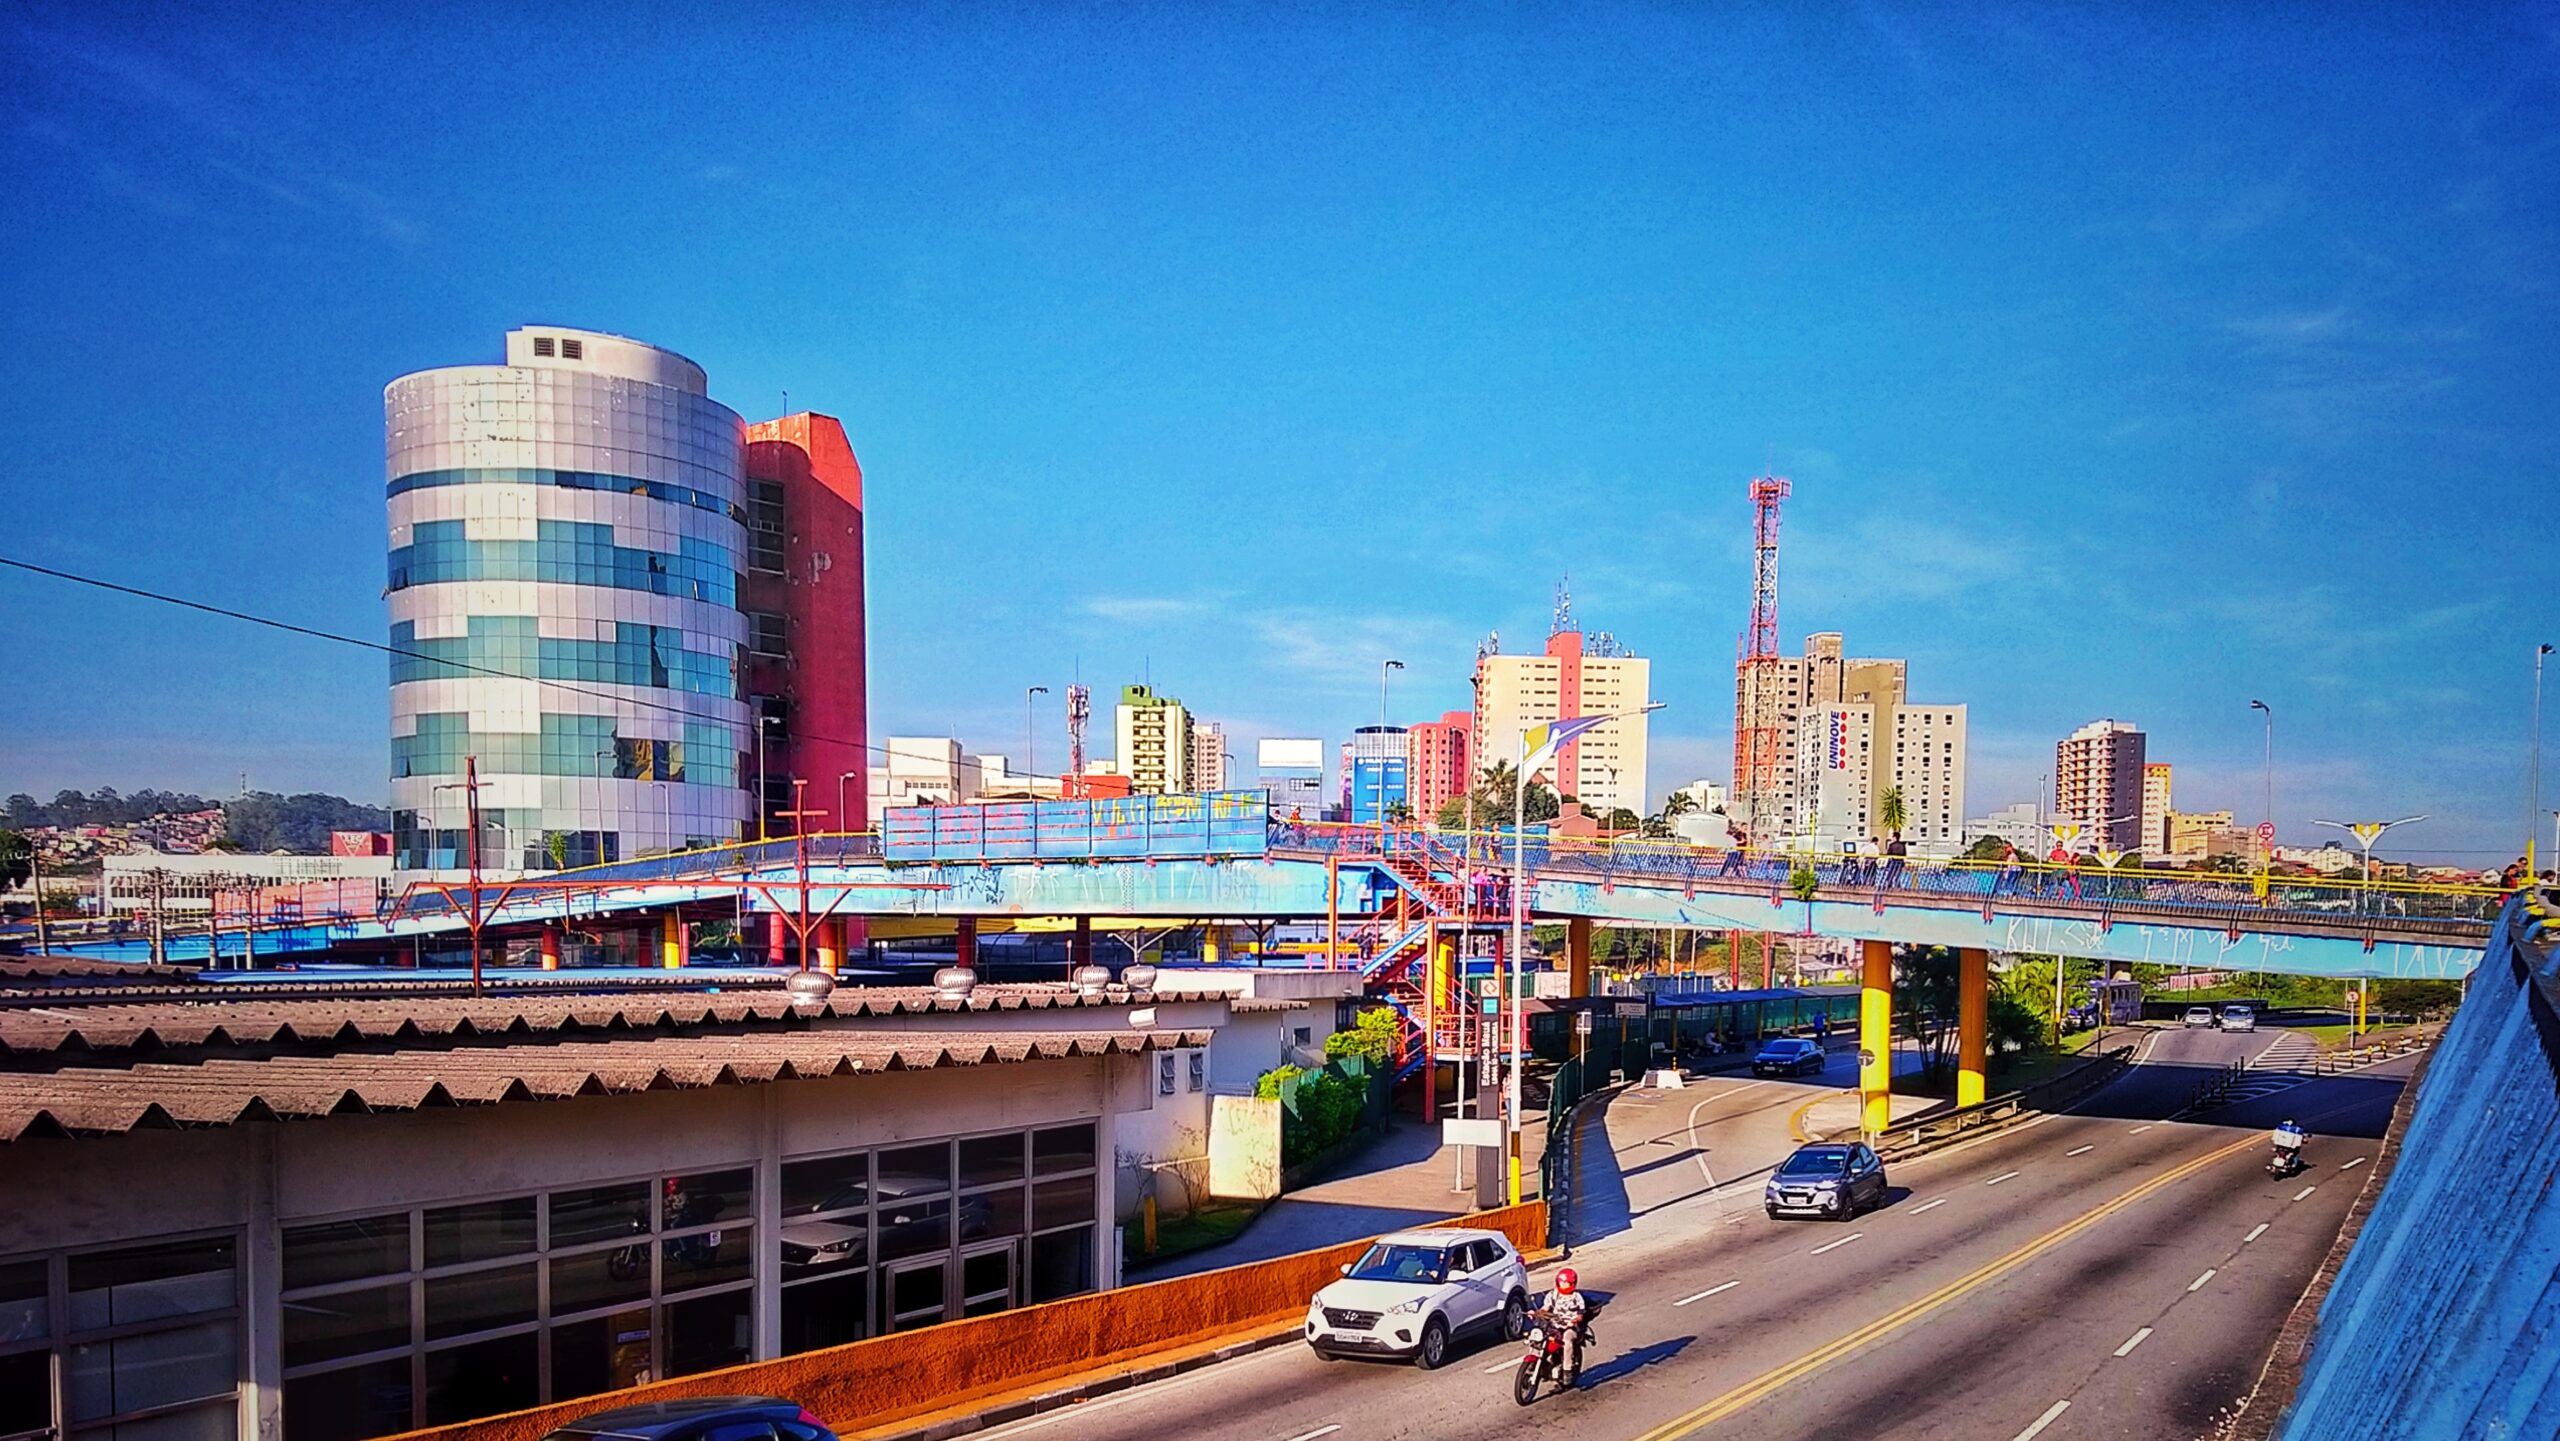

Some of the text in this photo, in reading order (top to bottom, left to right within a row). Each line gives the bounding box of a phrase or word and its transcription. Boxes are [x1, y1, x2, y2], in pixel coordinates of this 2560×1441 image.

[1829, 710, 1840, 769] UNINOVE
[1481, 1021, 1491, 1047] Mauá
[1481, 1048, 1491, 1086] Estação
